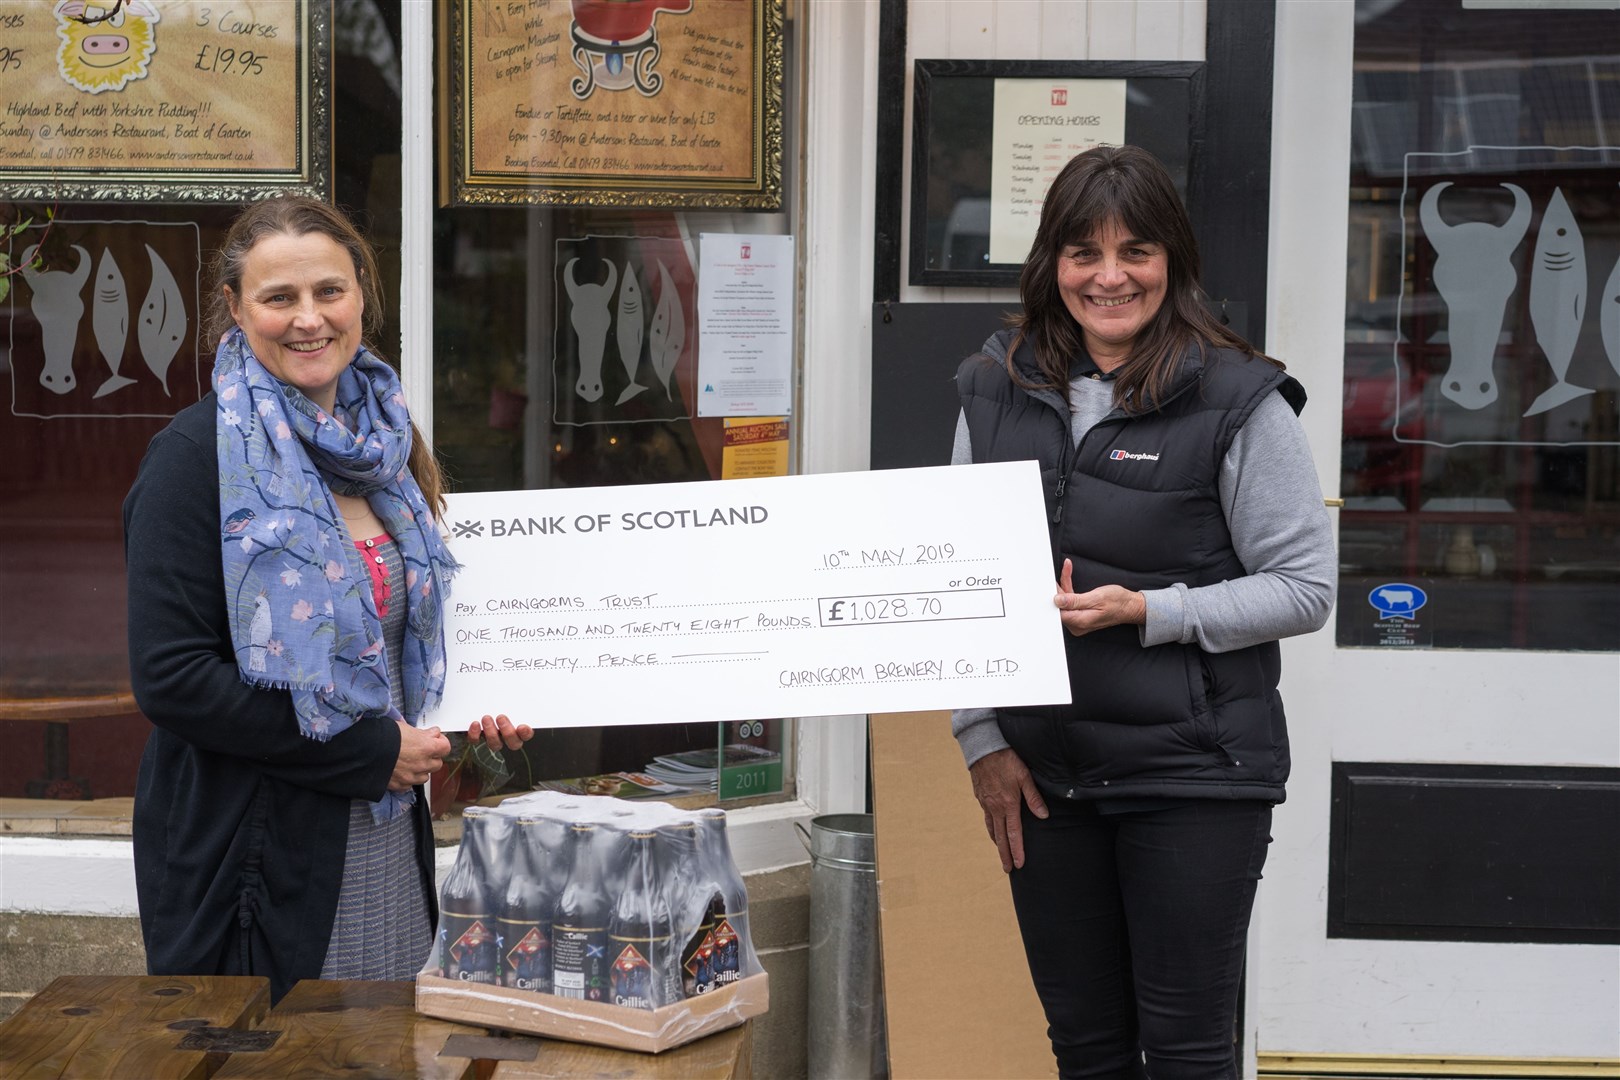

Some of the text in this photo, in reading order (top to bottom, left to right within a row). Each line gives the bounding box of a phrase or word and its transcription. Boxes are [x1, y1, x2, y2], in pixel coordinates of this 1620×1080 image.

[196, 8, 279, 38] 3 Courses
[525, 15, 543, 31] while
[487, 32, 560, 62] Cairngorm Mountain
[195, 44, 268, 75] £19.95
[506, 65, 521, 81] open
[523, 56, 533, 72] for
[7, 102, 211, 124] Highland Beef with Yorkshire Pudding!!!
[515, 103, 541, 119] Fondue
[544, 110, 554, 118] or
[597, 112, 612, 122] and
[621, 112, 637, 123] beer
[639, 115, 649, 123] or
[650, 114, 667, 124] wine
[669, 111, 680, 126] for
[683, 112, 697, 130] only
[1018, 114, 1101, 126] OPENING HOURS
[0, 122, 34, 142] Sunday
[39, 124, 54, 139] @
[112, 123, 169, 139] Restaurant,
[174, 123, 199, 137] Boat
[203, 122, 215, 139] of
[217, 122, 251, 138] Garten
[508, 128, 529, 148] 6pm
[578, 133, 590, 147] @
[589, 132, 626, 146] Andersons
[629, 133, 667, 147] Restaurant,
[670, 134, 688, 147] Boat
[690, 134, 699, 149] of
[699, 134, 721, 148] Garten
[40, 147, 53, 159] call
[56, 147, 85, 160] 01479
[504, 155, 529, 171] Booking
[563, 156, 577, 168] Call
[490, 505, 769, 538] BANK OF SCOTLAND
[861, 547, 905, 566] MAY
[916, 543, 955, 563] 2019
[949, 575, 1002, 588] or Order
[455, 593, 658, 615] Pay CAIRNGORMS TRUST
[456, 612, 812, 643] ONE THOUSAND AND TWENTY EIGHT POUNDS
[459, 653, 658, 674] AND SEVENTY PENCE
[779, 666, 864, 687] CAIRNGORM
[875, 660, 943, 681] BREWERY
[736, 770, 766, 790] 2011
[615, 994, 649, 1009] Caillie
